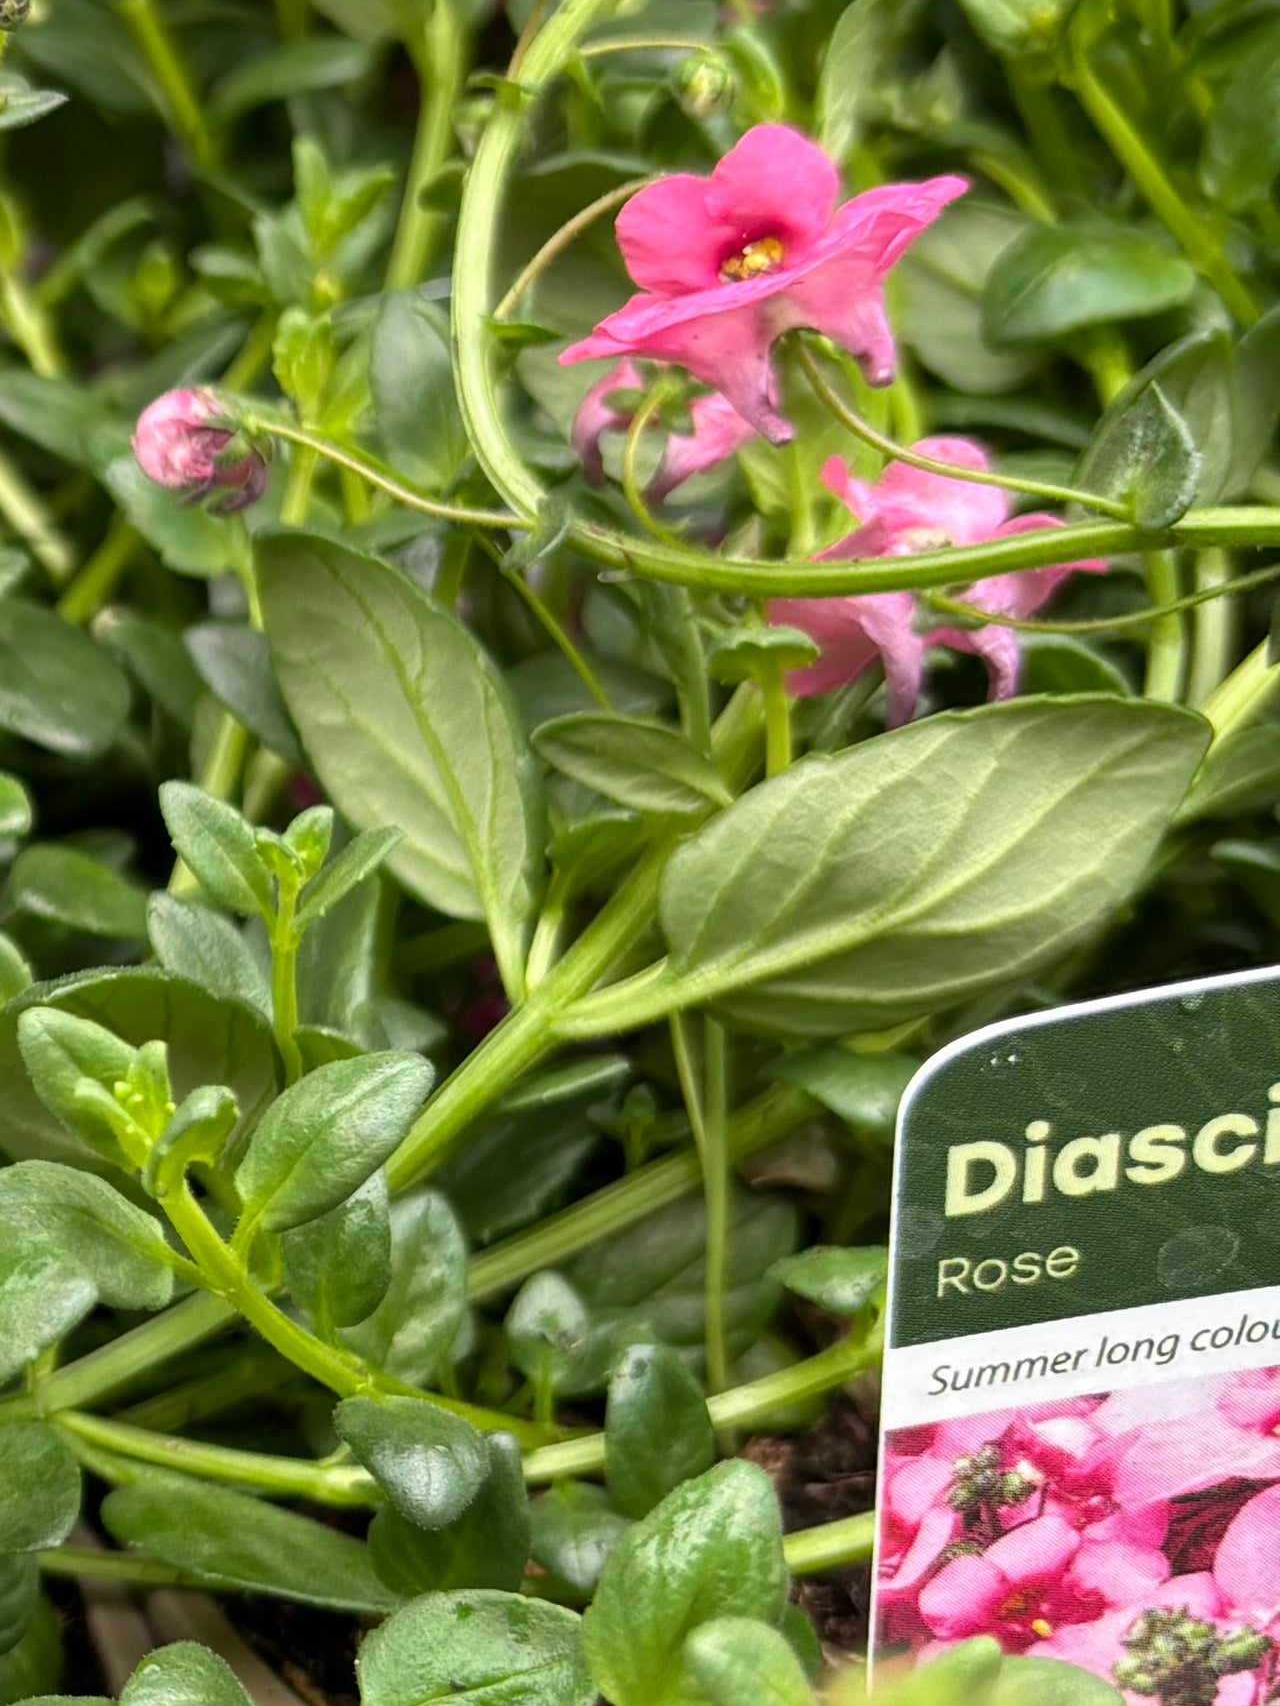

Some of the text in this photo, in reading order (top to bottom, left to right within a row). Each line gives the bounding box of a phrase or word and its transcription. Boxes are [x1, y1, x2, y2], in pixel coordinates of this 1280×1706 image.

[936, 1245, 1081, 1298] Rose
[929, 1349, 1088, 1395] Summer
[1096, 1336, 1180, 1366] long
